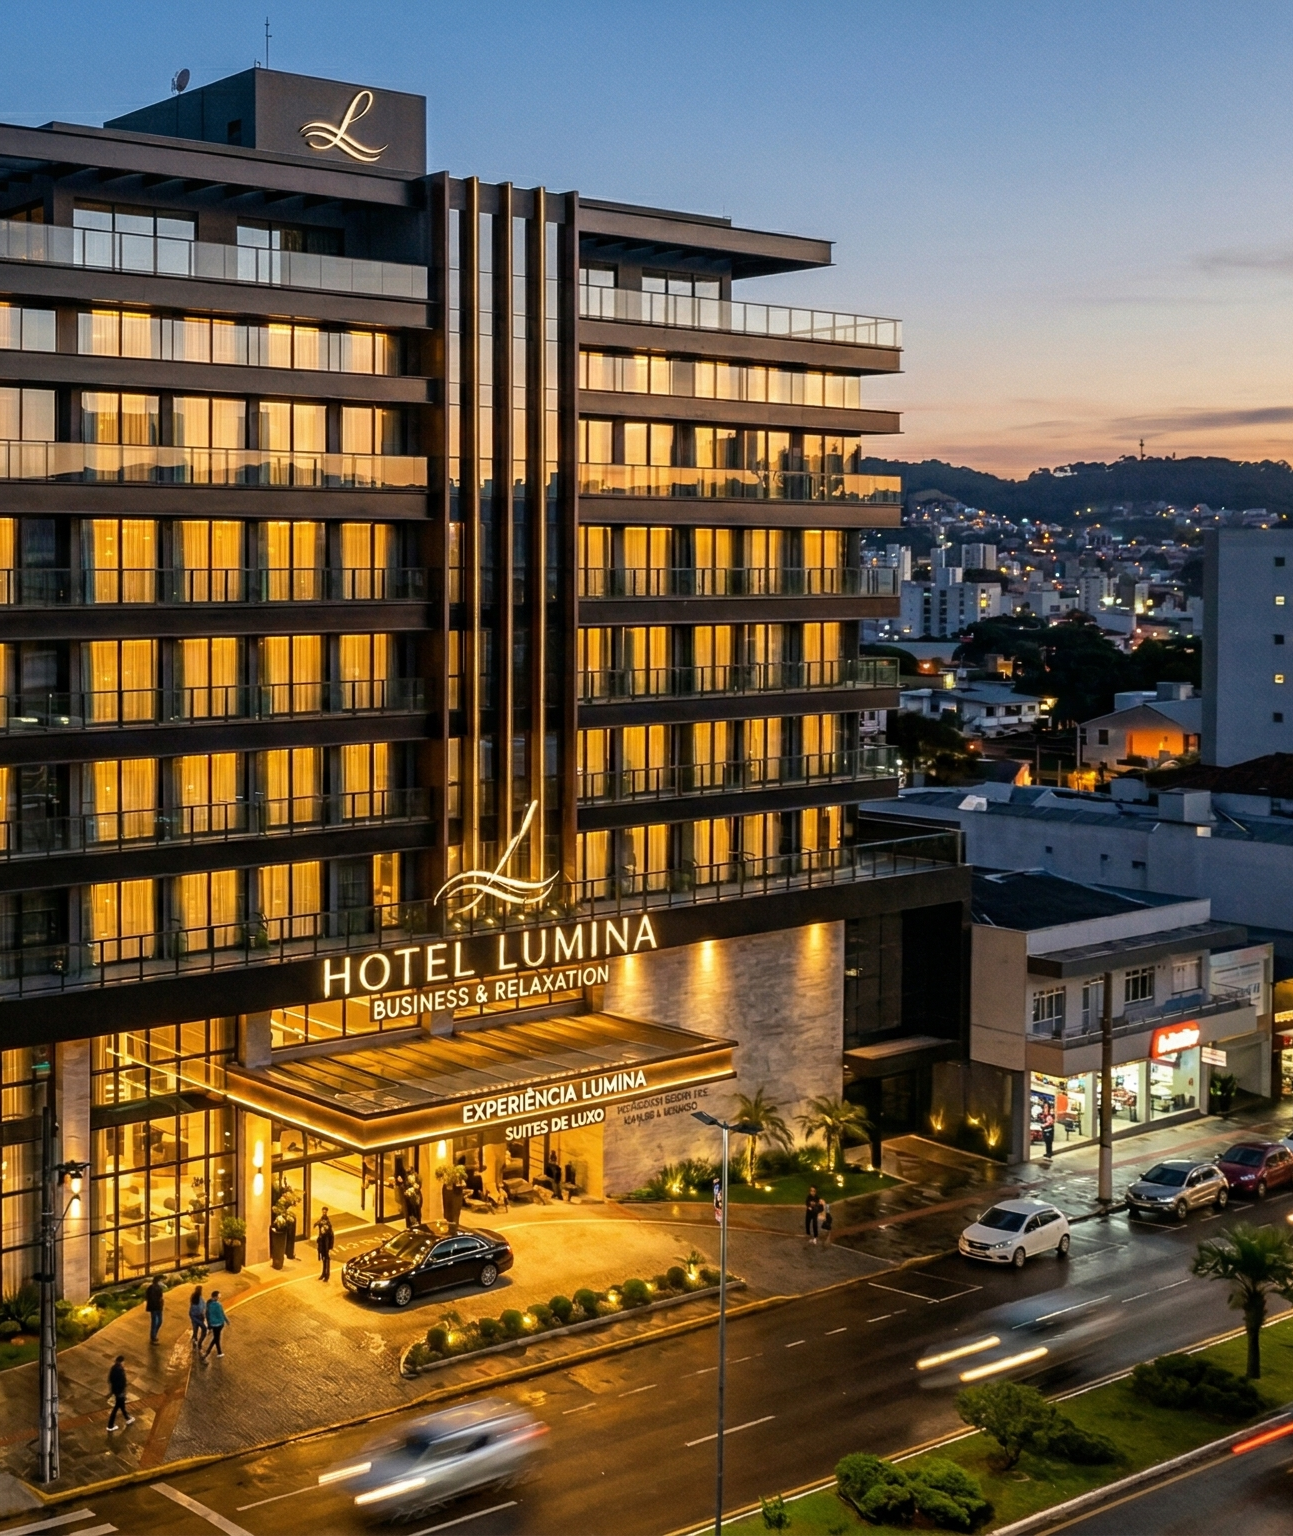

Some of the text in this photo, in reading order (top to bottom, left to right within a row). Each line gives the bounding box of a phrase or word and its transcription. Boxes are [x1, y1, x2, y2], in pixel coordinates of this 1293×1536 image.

[324, 914, 658, 999] HOTEL LUMINA
[373, 964, 609, 1020] BUSINESS & RELAXATION
[462, 1087, 577, 1124] EXPERIÊNCIA
[582, 1070, 647, 1100] LUMINA
[505, 1119, 549, 1141] SUITES
[551, 1115, 569, 1132] DE
[571, 1108, 605, 1127] LUXO
